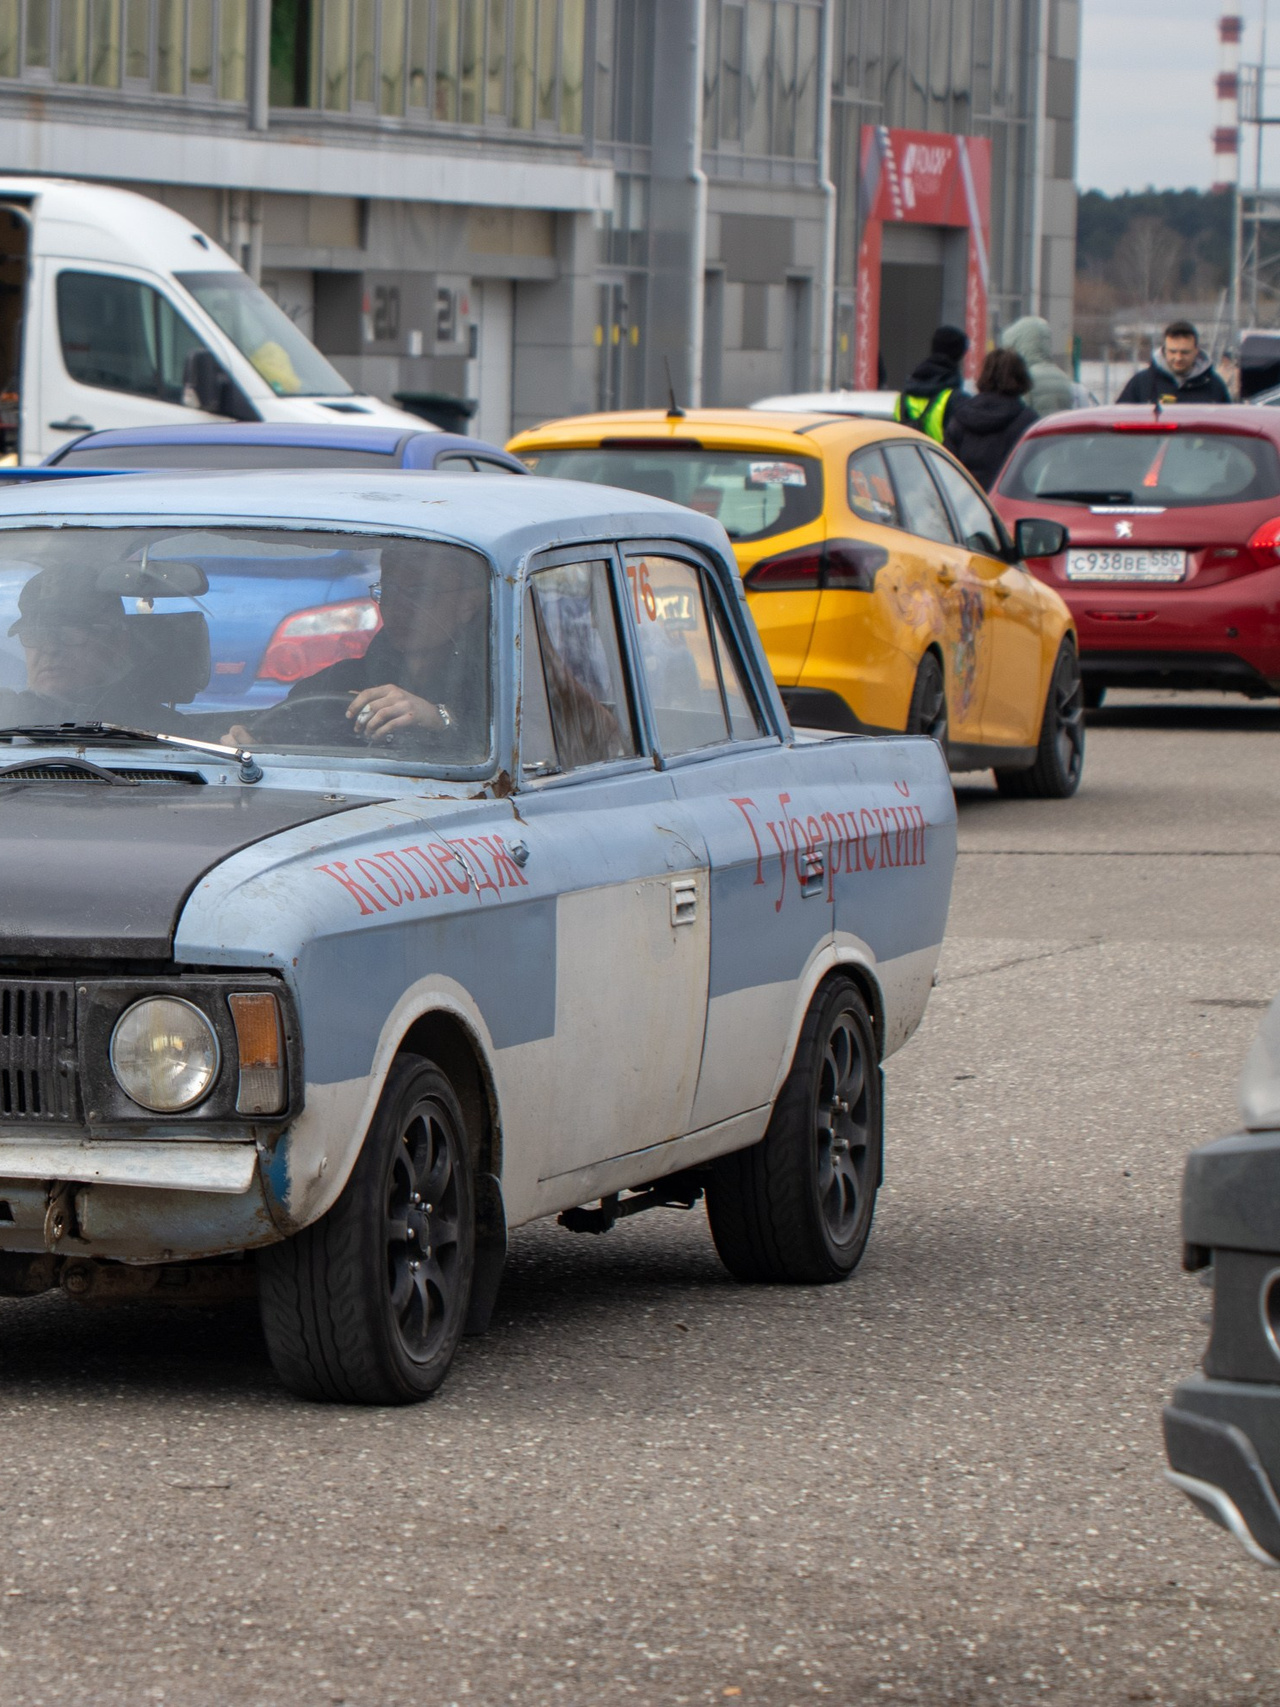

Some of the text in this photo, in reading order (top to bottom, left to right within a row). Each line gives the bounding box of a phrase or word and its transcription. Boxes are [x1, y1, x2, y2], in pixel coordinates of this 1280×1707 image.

[1073, 552, 1181, 571] С938ВЕ 550
[626, 562, 657, 625] 76
[728, 780, 927, 913] Губернский
